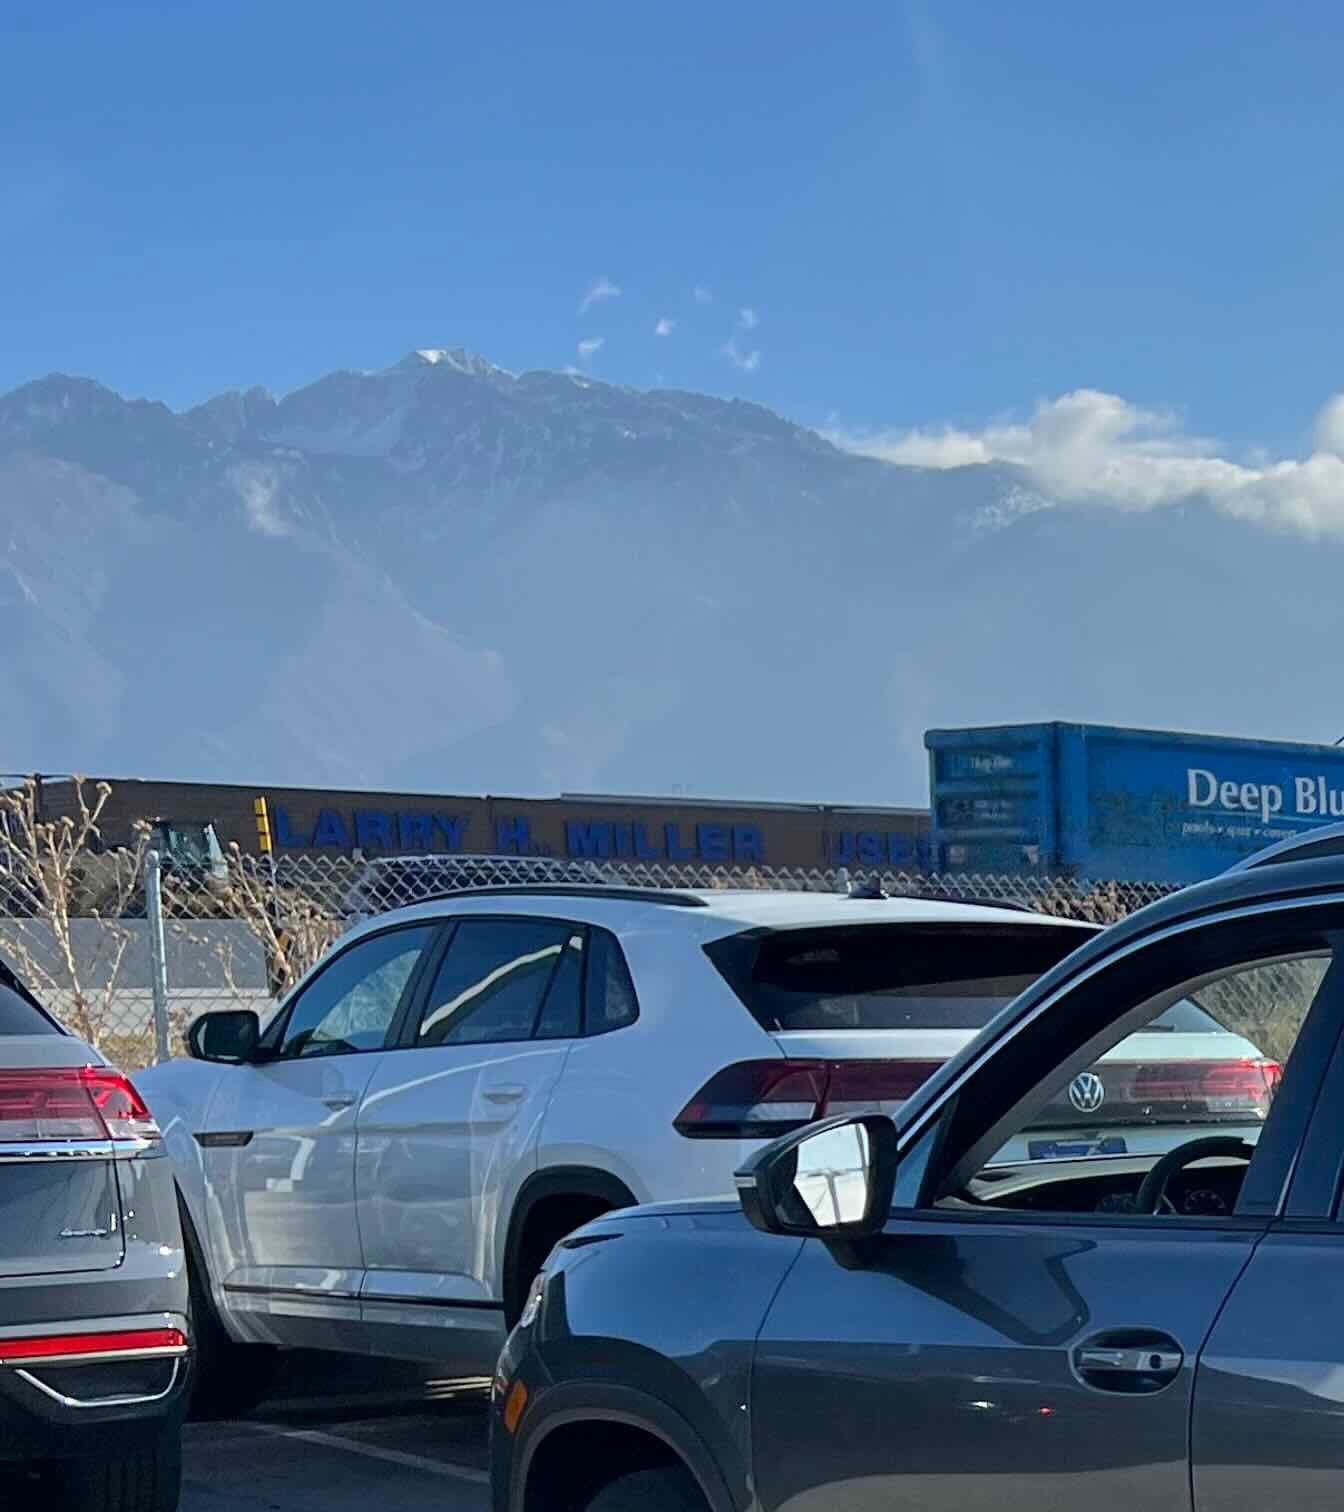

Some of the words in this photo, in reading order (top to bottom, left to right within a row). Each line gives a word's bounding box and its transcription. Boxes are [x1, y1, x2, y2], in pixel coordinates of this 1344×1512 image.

[1187, 768, 1282, 823] Deep
[273, 804, 467, 850] LARRY
[565, 819, 766, 862] MILLER
